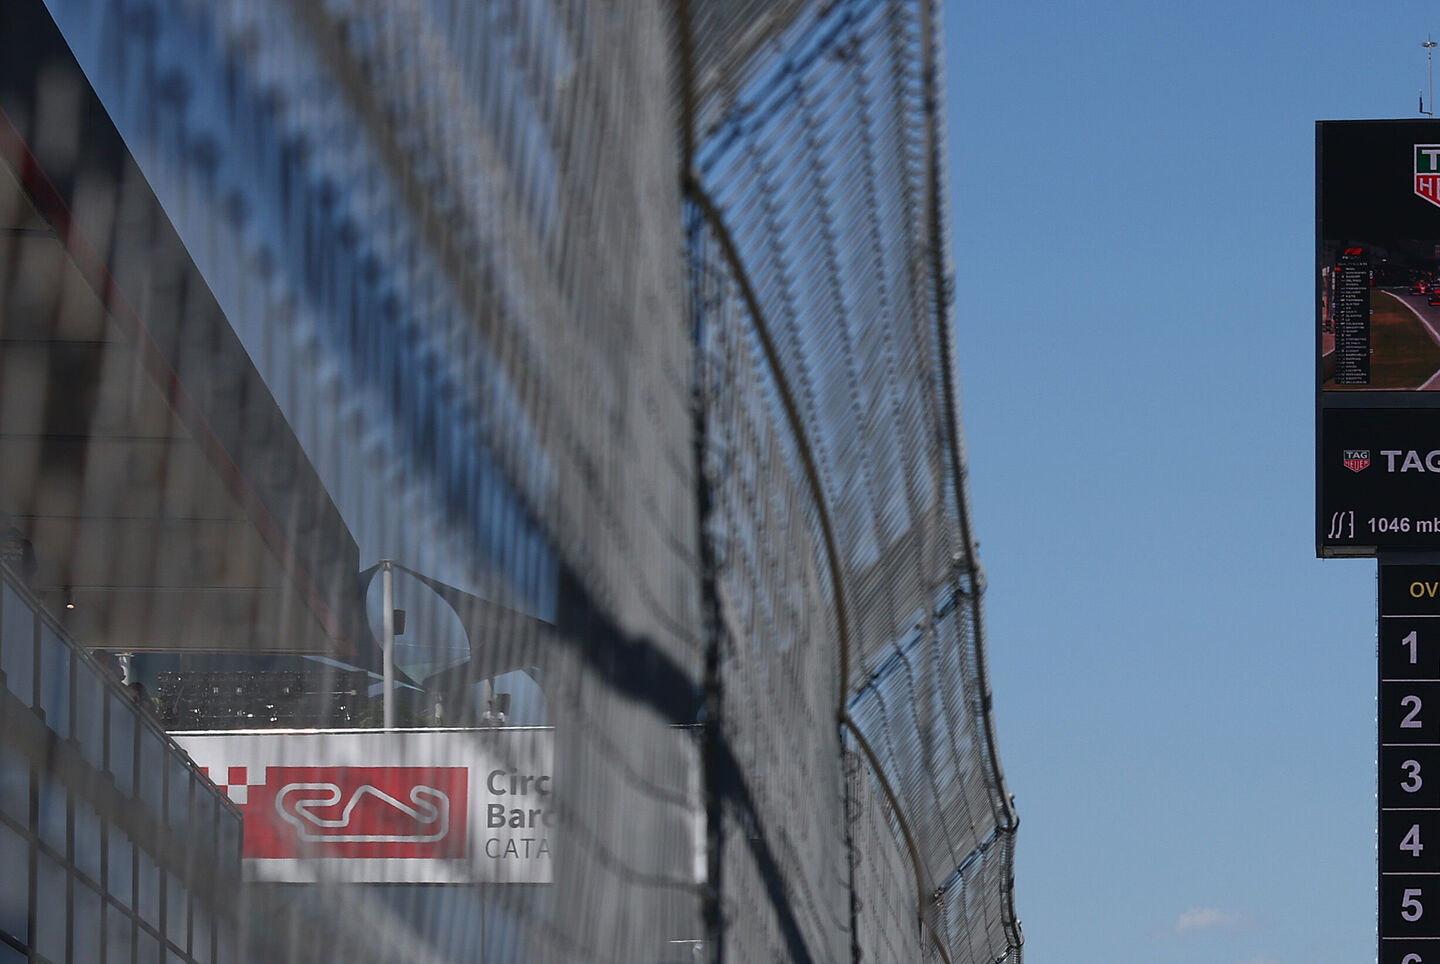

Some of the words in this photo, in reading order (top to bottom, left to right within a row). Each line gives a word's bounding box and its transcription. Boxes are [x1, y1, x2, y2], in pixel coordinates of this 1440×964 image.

[1344, 459, 1369, 471] HEUER
[1346, 451, 1368, 460] TAG
[1367, 517, 1410, 533] 1046
[1402, 630, 1417, 664] 1
[1400, 695, 1422, 728] 2
[1400, 759, 1423, 793] 3
[1399, 824, 1424, 857] 4
[1401, 888, 1424, 922] 5
